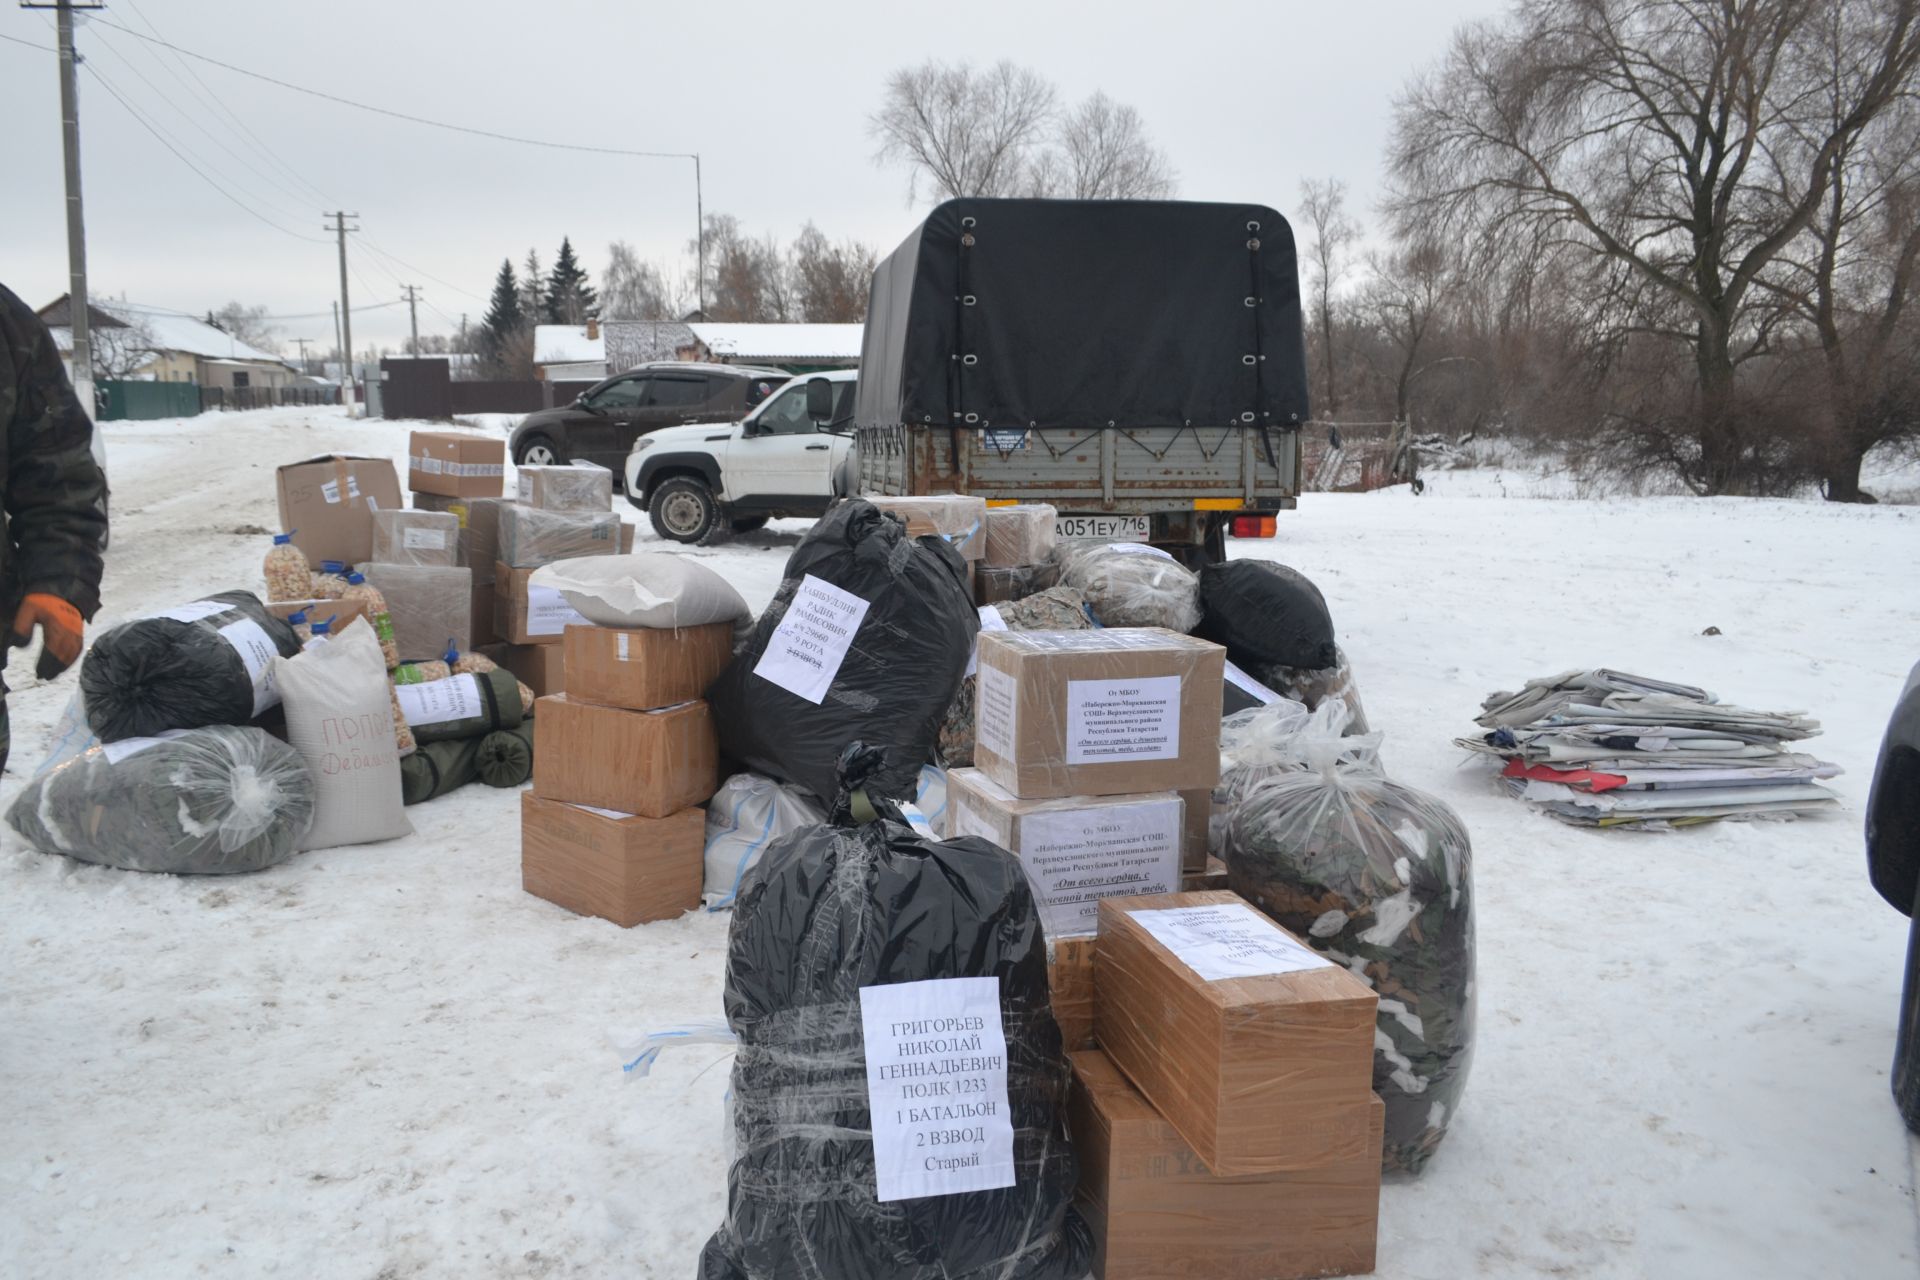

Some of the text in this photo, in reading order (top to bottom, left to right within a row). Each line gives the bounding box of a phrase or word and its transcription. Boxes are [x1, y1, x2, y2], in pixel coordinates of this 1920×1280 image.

[1121, 517, 1145, 531] 716
[803, 585, 857, 615] ХАБИБУЛЛИН
[807, 601, 837, 619] РАДИК
[795, 608, 847, 636] РАМИСОВИЧ
[804, 626, 829, 644] 29660
[795, 636, 824, 656] 9 РОТА
[1108, 689, 1117, 697] От
[1107, 709, 1164, 717] Верхнеуслонского
[1140, 717, 1162, 725] района
[1088, 728, 1125, 736] Республики
[1083, 825, 1121, 836] От МБОУ
[1033, 845, 1170, 864] Верхнеуслонского муниципального
[1043, 856, 1160, 876] района Республики Татарстан
[1079, 875, 1104, 887] всего
[1106, 872, 1142, 885] сердца,
[1084, 889, 1139, 901] теплотой,
[1141, 883, 1168, 894] тебе,
[891, 1017, 985, 1037] ГРИГОРЬЕВ
[899, 1034, 983, 1057] НИКОЛАЙ
[880, 1056, 1002, 1080] ГЕННАДЬЕВИЧ
[903, 1078, 988, 1100] ПОЛК 1233
[897, 1101, 997, 1125] 1 БАТАЛЬОН
[917, 1127, 985, 1147] 2 ВЗВОД
[925, 1153, 980, 1173] Старый
